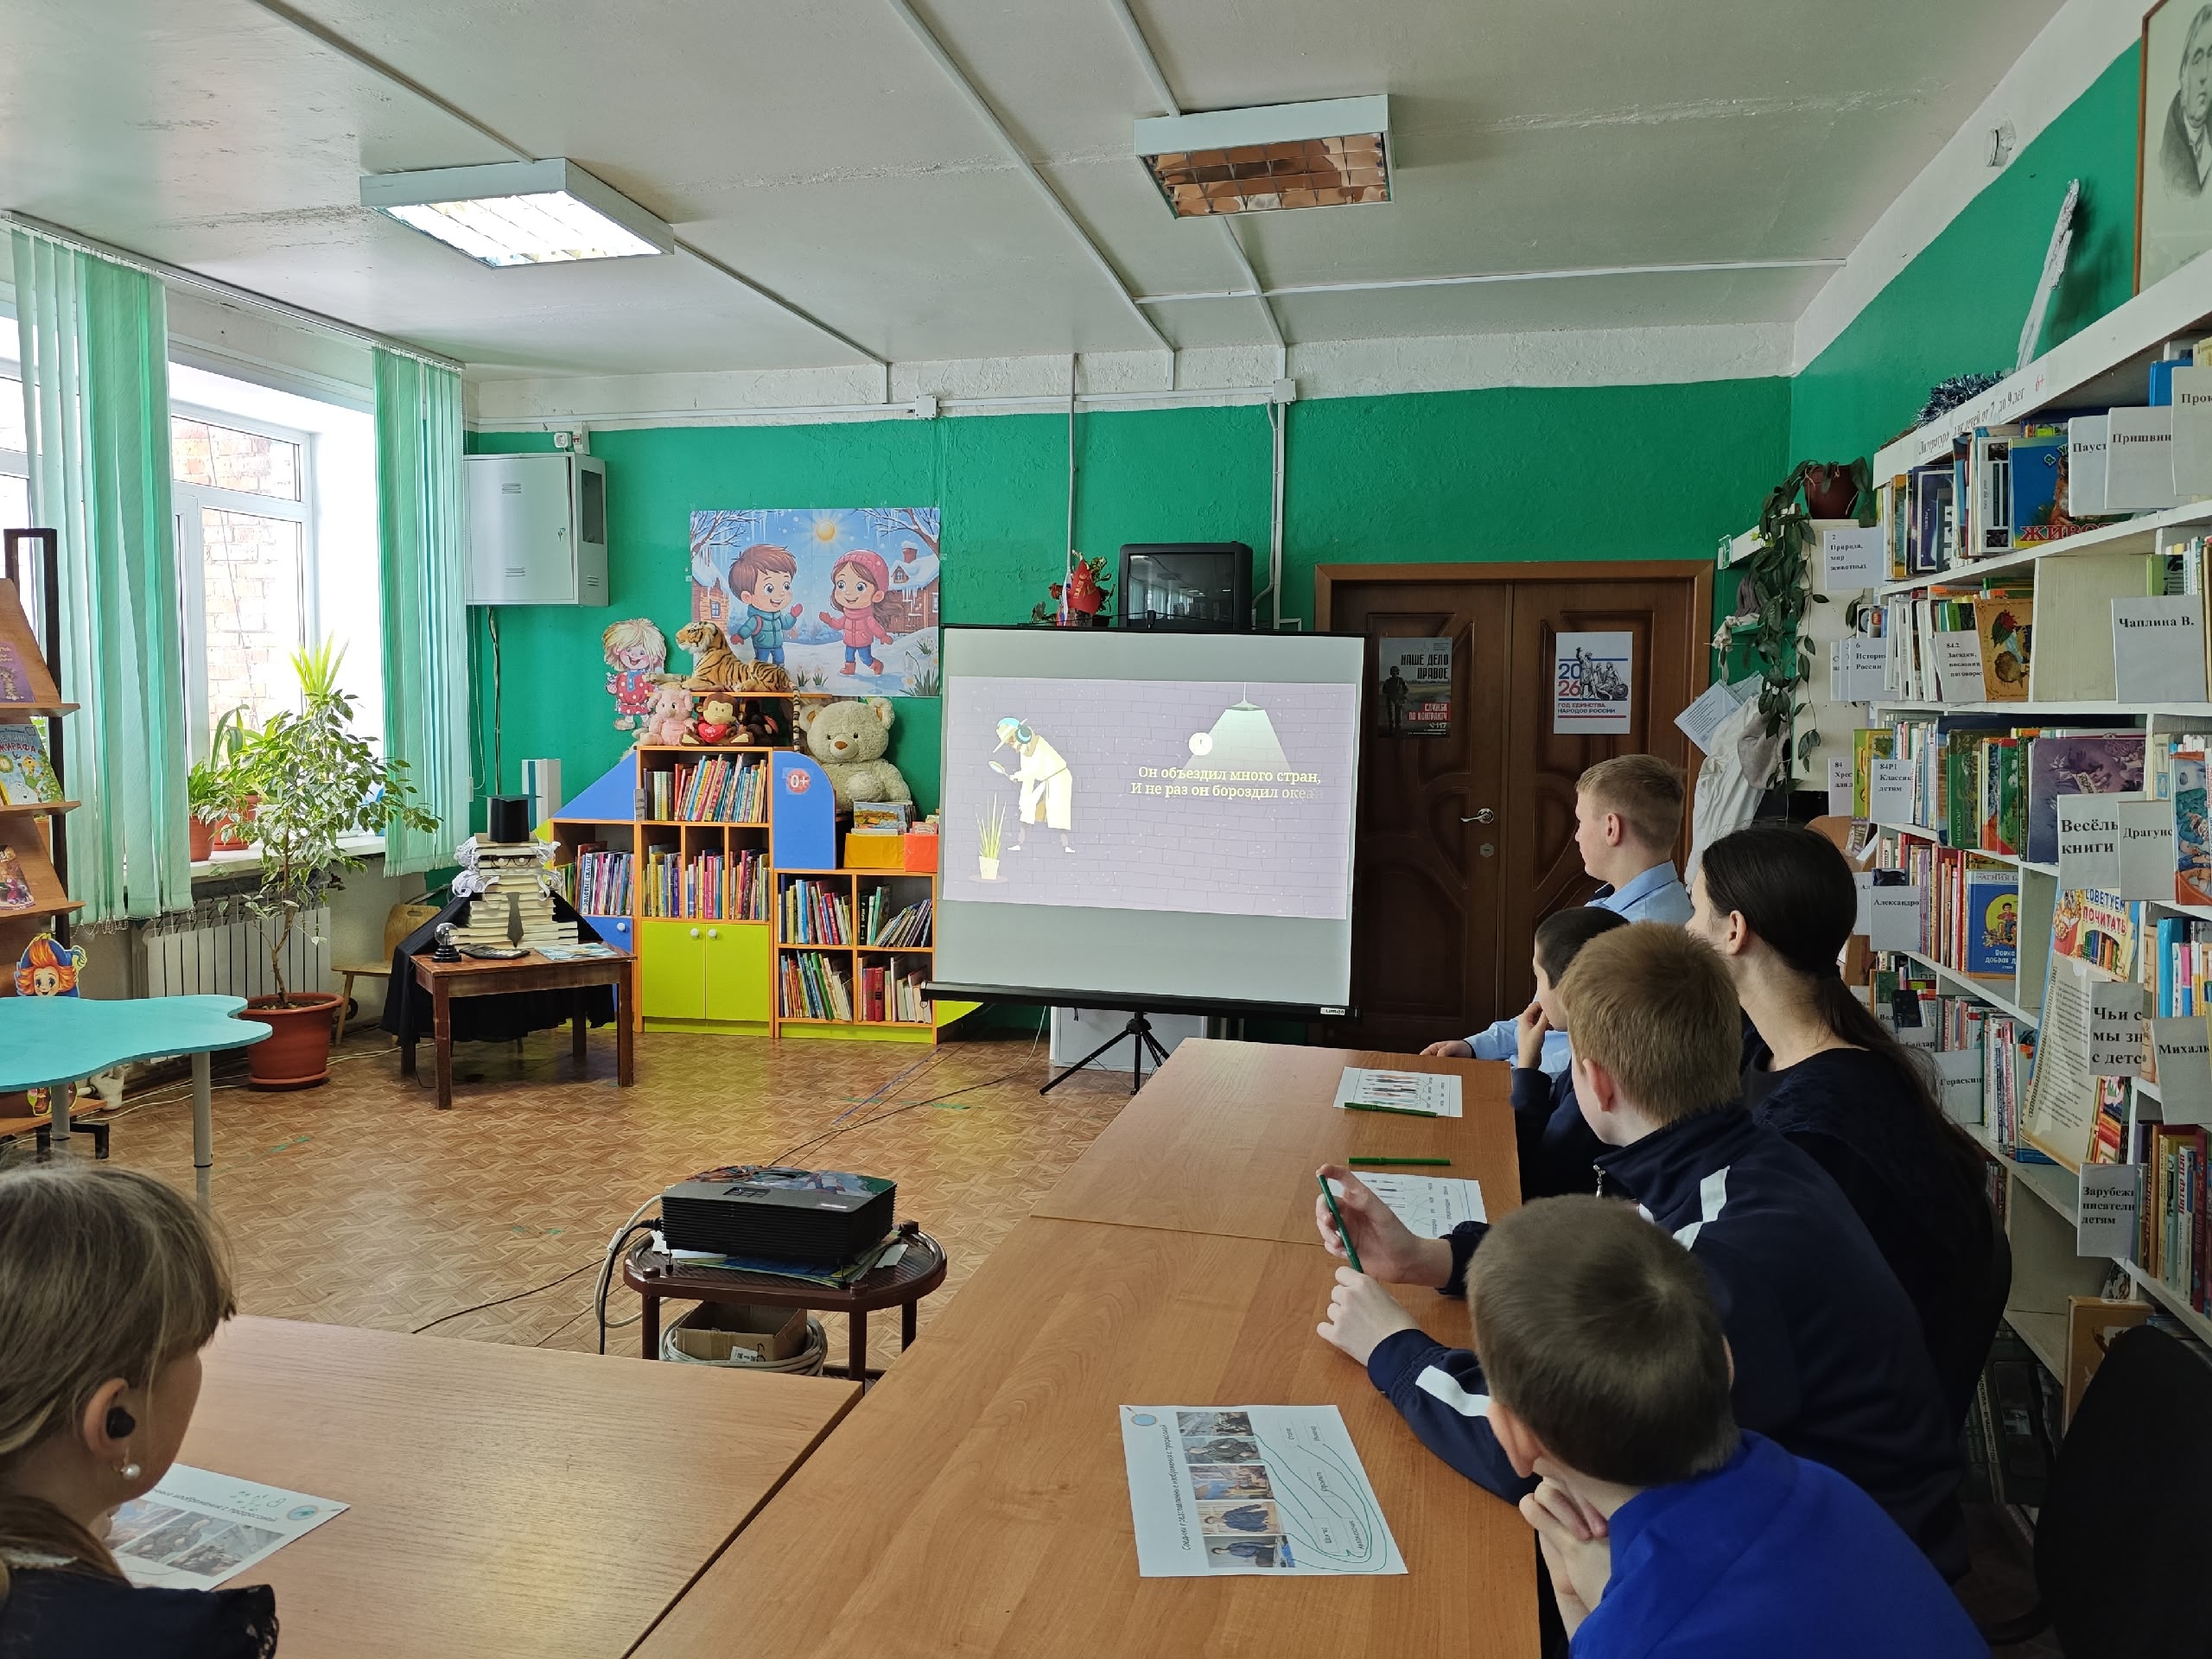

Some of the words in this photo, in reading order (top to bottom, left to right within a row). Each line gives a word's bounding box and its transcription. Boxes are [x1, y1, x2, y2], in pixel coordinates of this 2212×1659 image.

[1990, 401, 1996, 418] 7
[2035, 373, 2045, 392] 6+
[2119, 618, 2177, 628] Чаплина
[2181, 616, 2195, 626] В.
[1400, 653, 1425, 666] НАШЕ
[1427, 653, 1449, 666] ДЕЛО
[1416, 667, 1449, 680] ПРАВОЕ
[1558, 663, 1582, 680] 20
[1558, 679, 1581, 697] 26
[789, 774, 810, 789] 0+
[1138, 766, 1158, 779] Он
[1160, 766, 1227, 781] объездил
[1229, 769, 1274, 782] много
[1276, 771, 1321, 785] стран,
[1130, 782, 1142, 794] И
[1145, 784, 1162, 795] не
[1165, 785, 1188, 798] раз
[1191, 785, 1210, 797] он
[1211, 785, 1279, 800] бороздил
[2061, 842, 2114, 855] книги
[2082, 906, 2127, 936] ПОЧИТАТЬ
[2094, 1007, 2128, 1020] Чьи
[2093, 1032, 2120, 1043] мы
[2091, 1053, 2101, 1063] с
